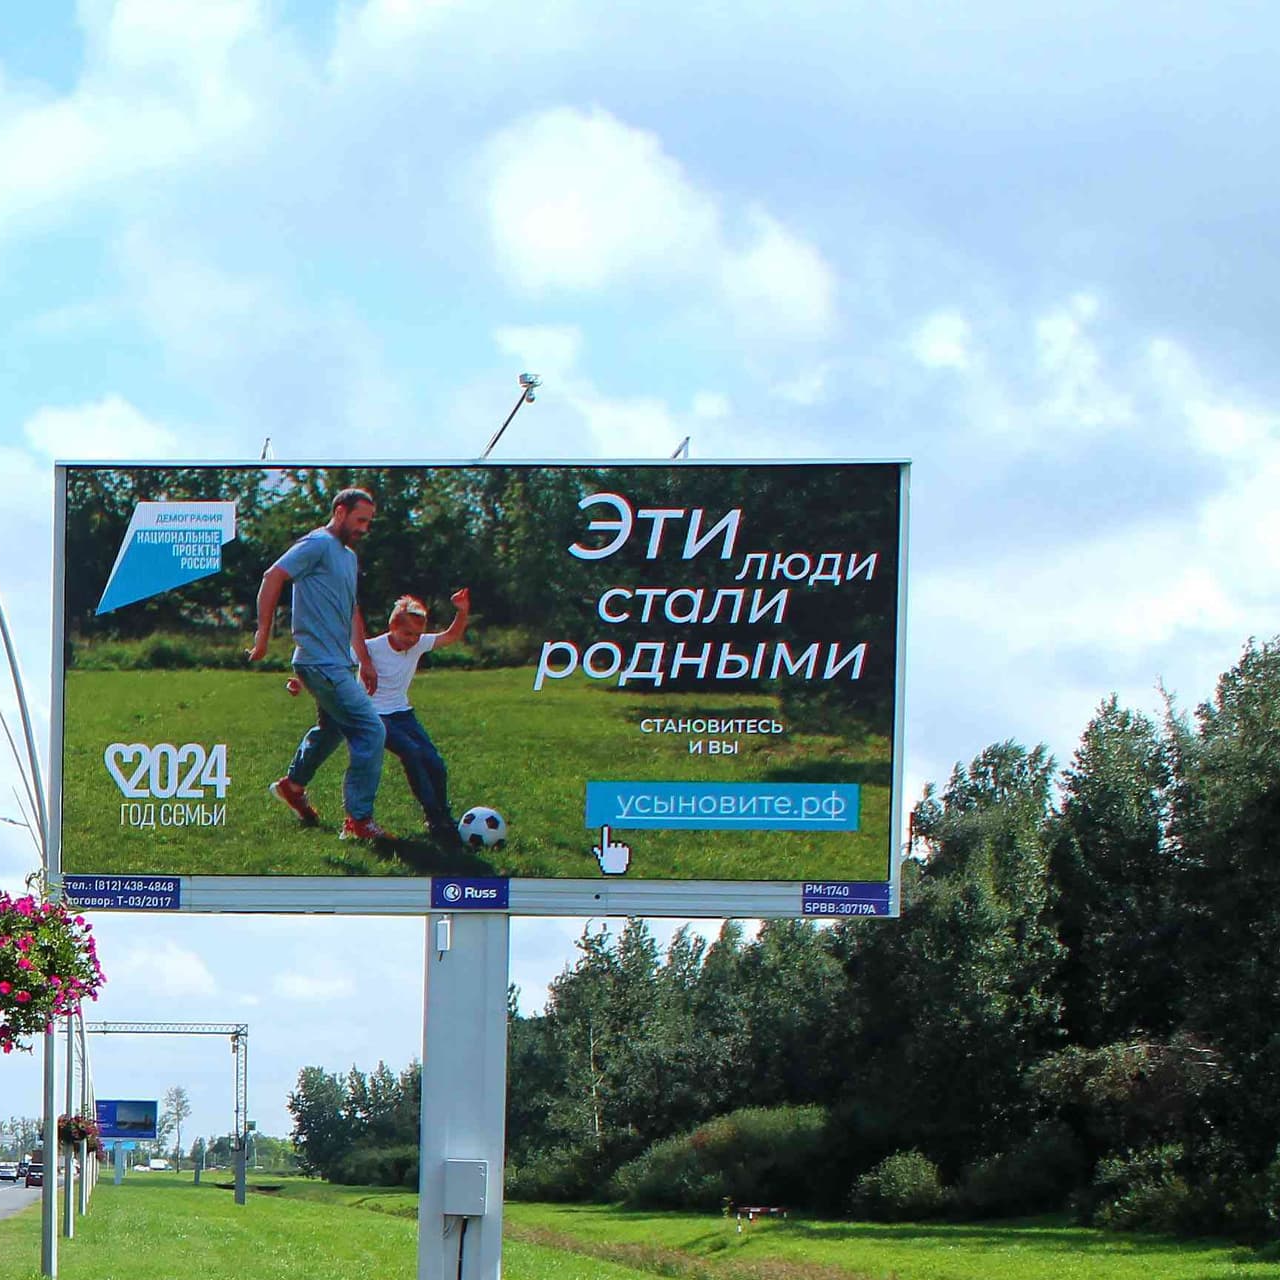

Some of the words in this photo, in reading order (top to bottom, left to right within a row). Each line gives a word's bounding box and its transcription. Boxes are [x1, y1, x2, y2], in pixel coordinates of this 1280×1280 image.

[156, 513, 223, 524] ДЕМОГРАФИЯ
[136, 531, 220, 544] НАЦИОНАЛЬНЫЕ
[568, 492, 742, 560] Эти
[735, 552, 878, 586] люди
[172, 545, 220, 556] ПРОЕКТЫ
[180, 557, 220, 569] РОССИИ
[597, 588, 789, 624] стали
[533, 641, 868, 691] родными
[640, 719, 783, 734] СТАНОВИТЕСЬ
[689, 741, 702, 754] И
[709, 741, 739, 754] ВЫ
[104, 743, 231, 798] 2024
[616, 790, 847, 820] усыновите.рф
[120, 803, 156, 830] ГОД
[95, 880, 122, 892] (812)
[123, 881, 174, 892] 438-4848
[464, 886, 497, 899] Russ
[805, 902, 876, 914] SPBB:30719A
